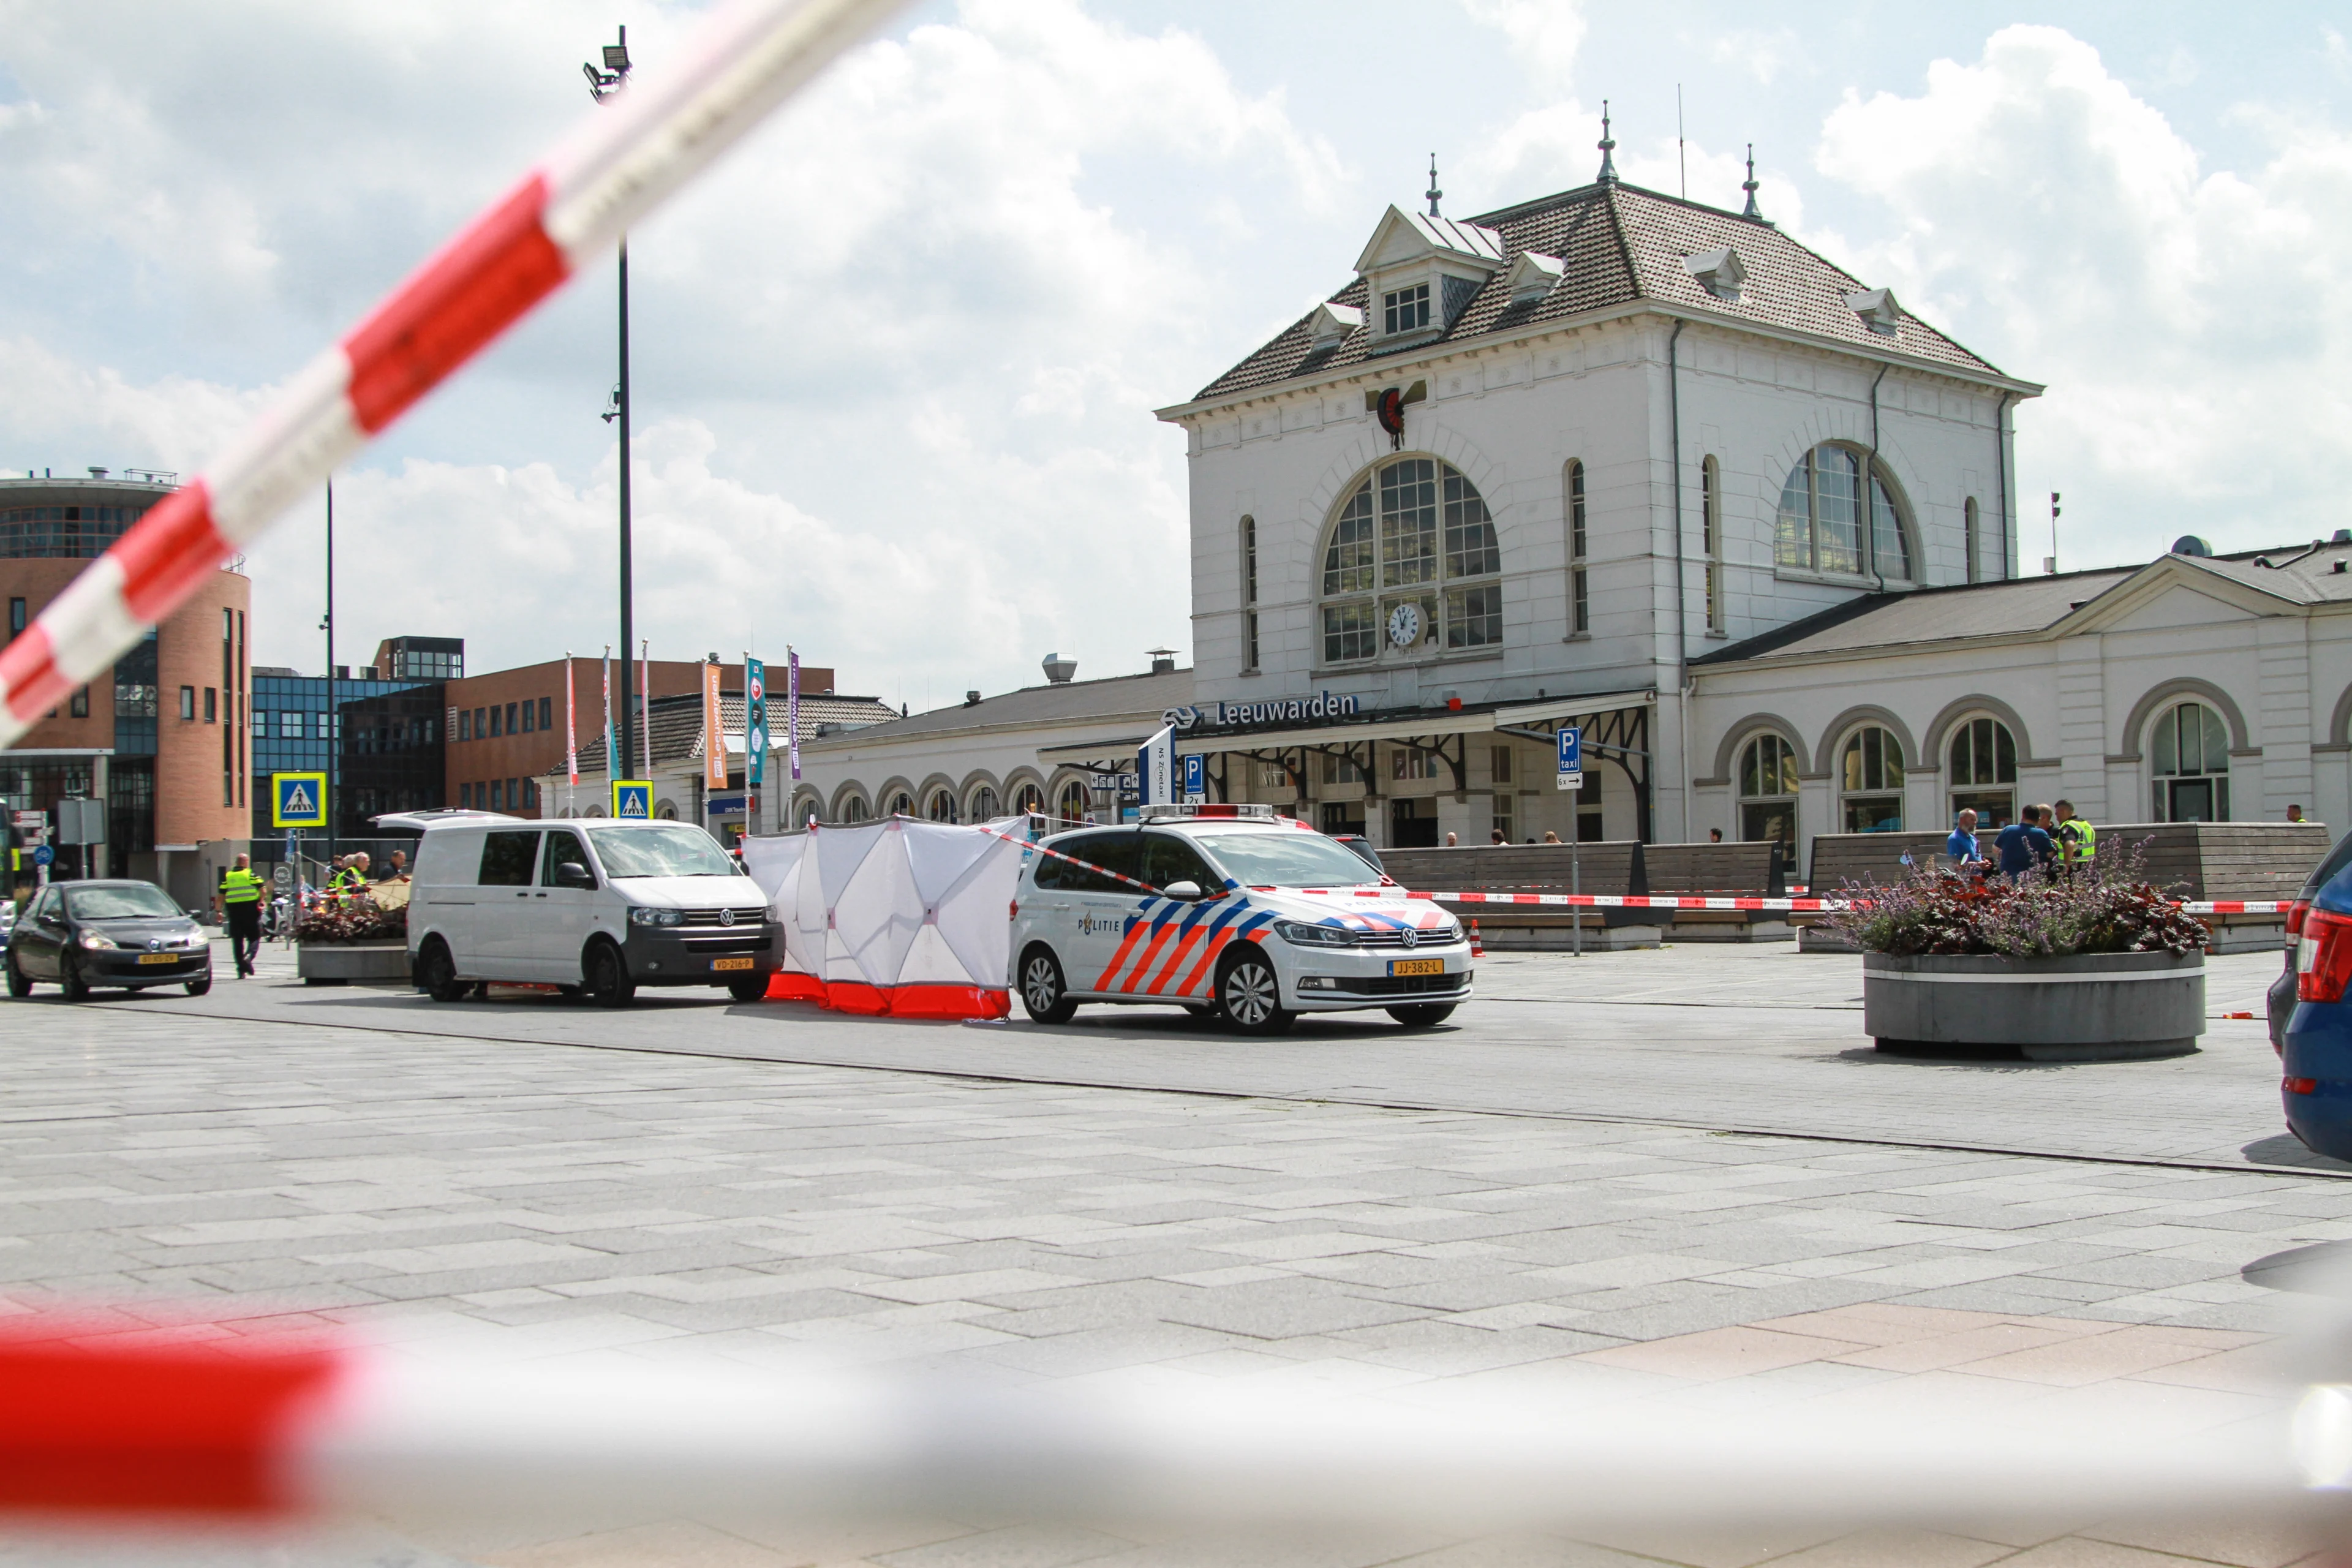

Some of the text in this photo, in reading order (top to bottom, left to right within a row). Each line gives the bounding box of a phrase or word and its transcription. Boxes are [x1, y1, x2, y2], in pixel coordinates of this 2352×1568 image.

[1216, 690, 1357, 726] Leeuwarden
[712, 675, 722, 760] Leeuwarden
[1562, 733, 1574, 755] P
[1158, 747, 1164, 759] NS
[1189, 760, 1198, 779] P
[1561, 759, 1577, 769] taxi
[1078, 918, 1119, 935] POLITIE
[715, 959, 750, 969] VD-216-P
[1398, 961, 1438, 974] JJ-382-L
